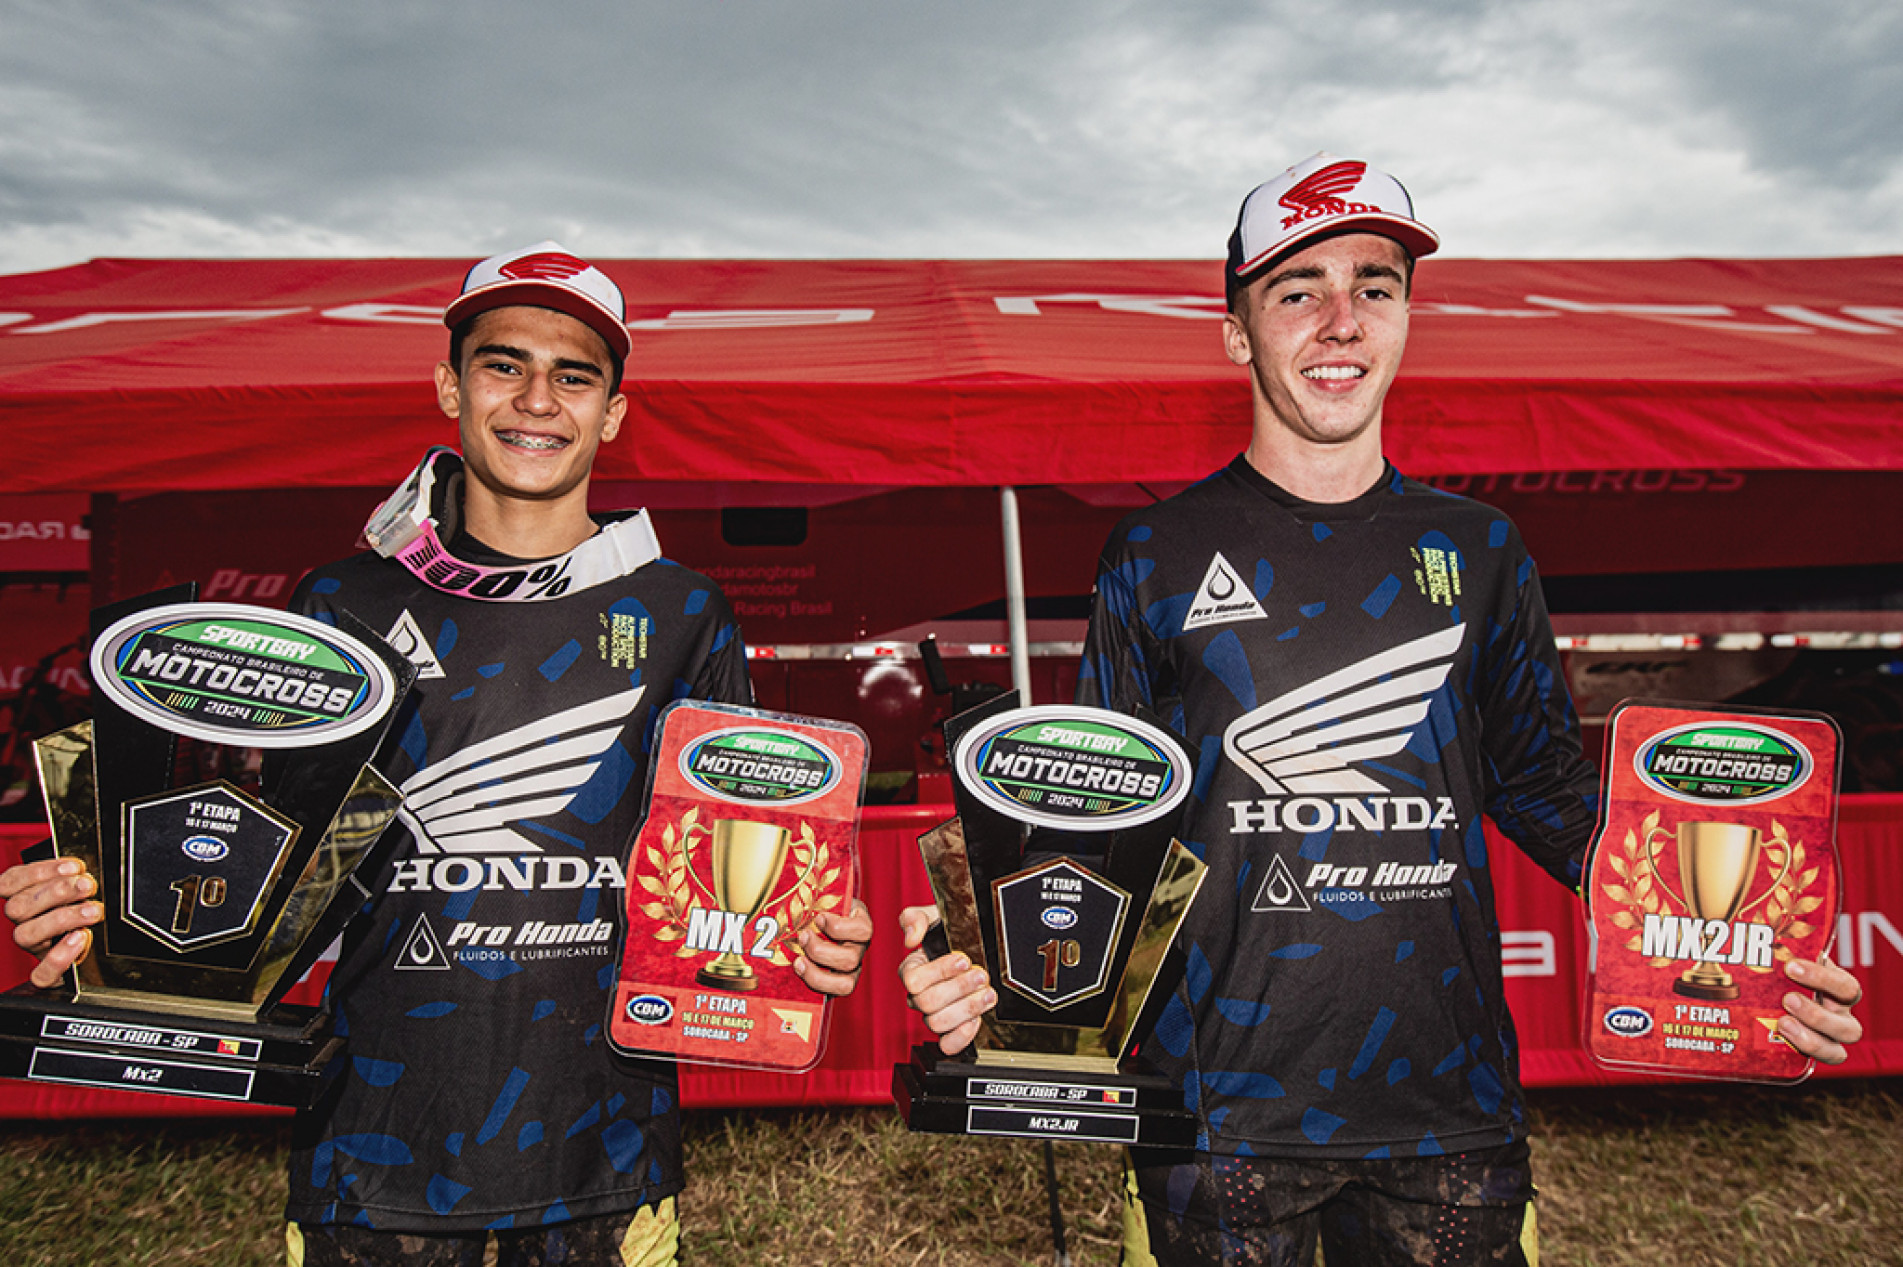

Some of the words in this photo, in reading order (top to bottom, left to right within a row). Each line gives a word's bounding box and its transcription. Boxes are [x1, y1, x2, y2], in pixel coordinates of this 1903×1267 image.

[1424, 469, 1748, 494] OTOCROSS
[204, 568, 289, 598] Pro
[734, 601, 787, 619] Racing
[790, 601, 833, 616] Brasil
[200, 625, 317, 661] SPORTBAY
[172, 643, 245, 666] CAMPEONATO
[247, 655, 308, 680] BRASILEIRO
[308, 671, 325, 681] DE
[130, 648, 354, 714] MOTOCROSS
[203, 700, 252, 720] 2024
[1037, 726, 1128, 753] SPORTBAY
[696, 753, 824, 788] MOTOCROSS
[987, 751, 1161, 798] MOTOCROSS
[1653, 753, 1793, 783] MOTOCROSS
[202, 803, 241, 822] ETAPA
[1047, 792, 1084, 809] 2024
[1227, 796, 1460, 834] HONDA
[387, 856, 627, 892] HONDA
[1053, 878, 1083, 892] ETAPA
[1305, 863, 1369, 888] Pro
[1371, 858, 1458, 887] Honda
[1313, 891, 1365, 903] FLUIDOS
[1369, 890, 1377, 902] E
[446, 921, 513, 947] Pro
[514, 917, 614, 946] Honda
[685, 907, 747, 955] MX
[750, 916, 780, 958] 2
[1641, 913, 1775, 968] MX2JR
[453, 950, 505, 962] FLUIDOS
[511, 949, 517, 961] E
[521, 945, 610, 961] LUBRIFICANTES
[633, 1003, 666, 1017] CBM
[708, 995, 748, 1015] ETAPA
[1689, 1005, 1730, 1025] ETAPA
[1610, 1014, 1645, 1030] CBM
[64, 1023, 163, 1045] SOROCABA
[171, 1034, 200, 1048] SP
[1066, 1088, 1088, 1100] SP
[1028, 1116, 1080, 1132] MX2JR
